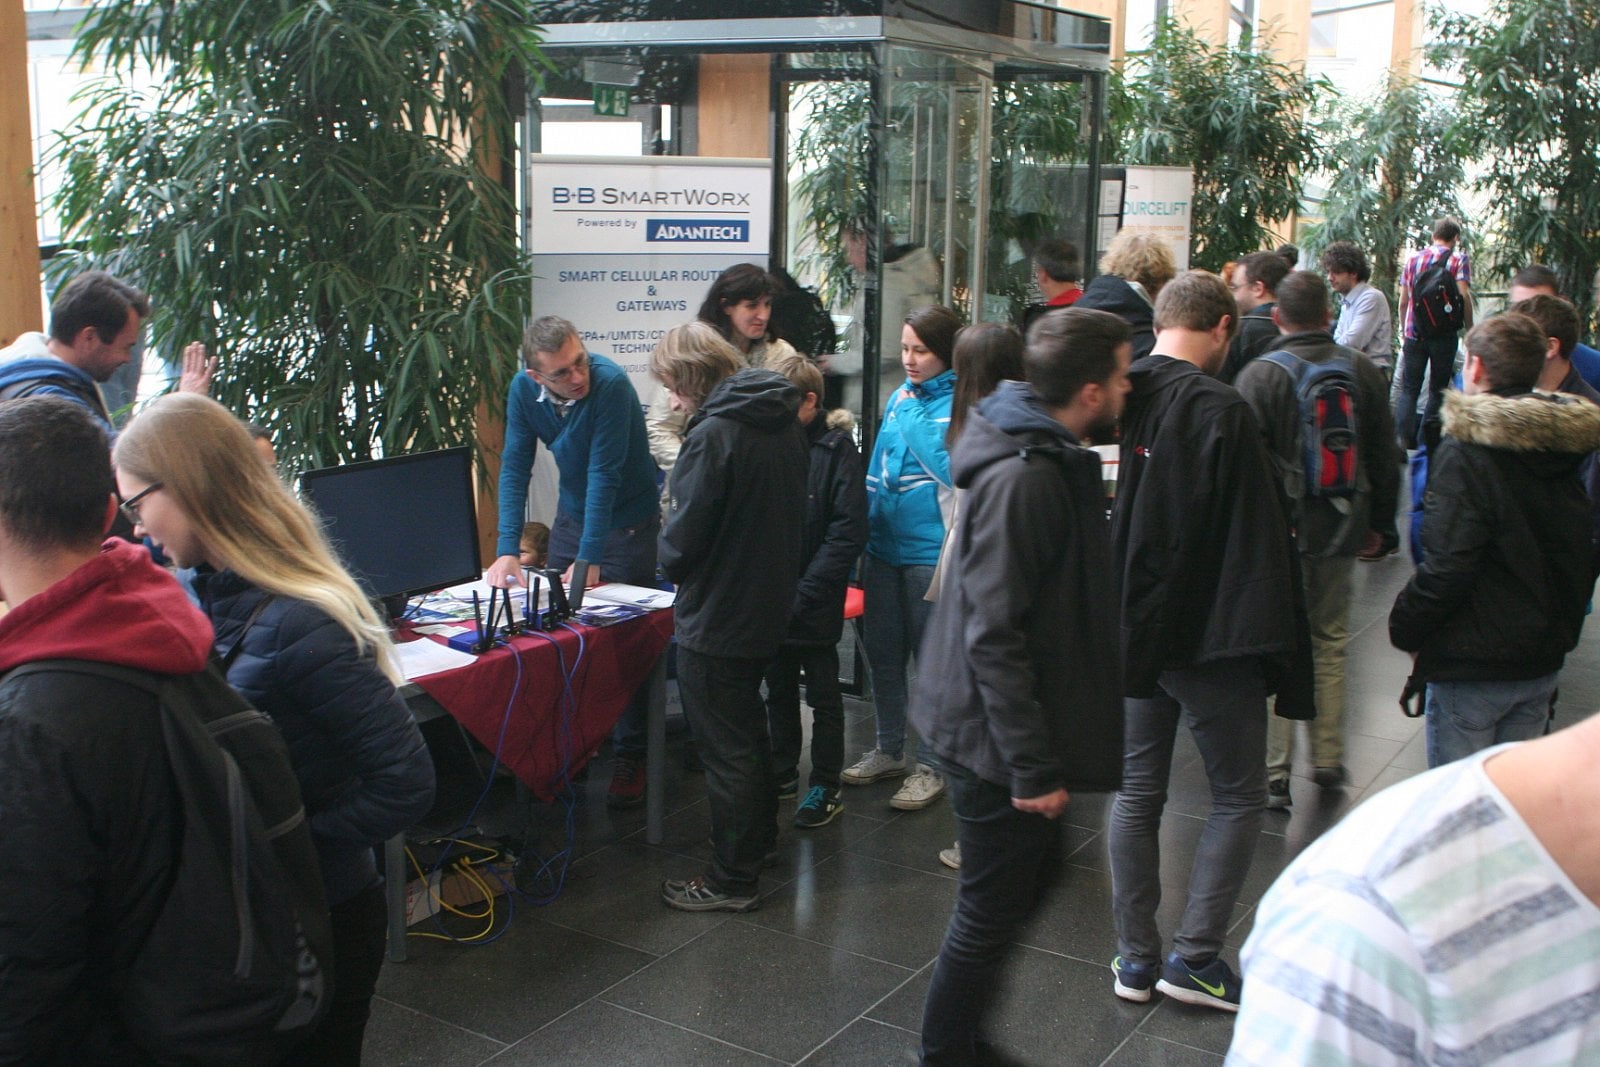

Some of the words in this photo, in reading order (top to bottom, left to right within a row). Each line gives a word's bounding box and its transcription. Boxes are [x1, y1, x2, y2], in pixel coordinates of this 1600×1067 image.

[552, 187, 596, 204] B+B
[576, 218, 622, 228] Powered
[624, 218, 637, 229] by
[655, 224, 742, 241] ADVANTECH
[558, 270, 607, 283] SMART
[611, 270, 679, 282] CELLULAR
[647, 285, 657, 297] &
[616, 300, 687, 312] GATEWAYS
